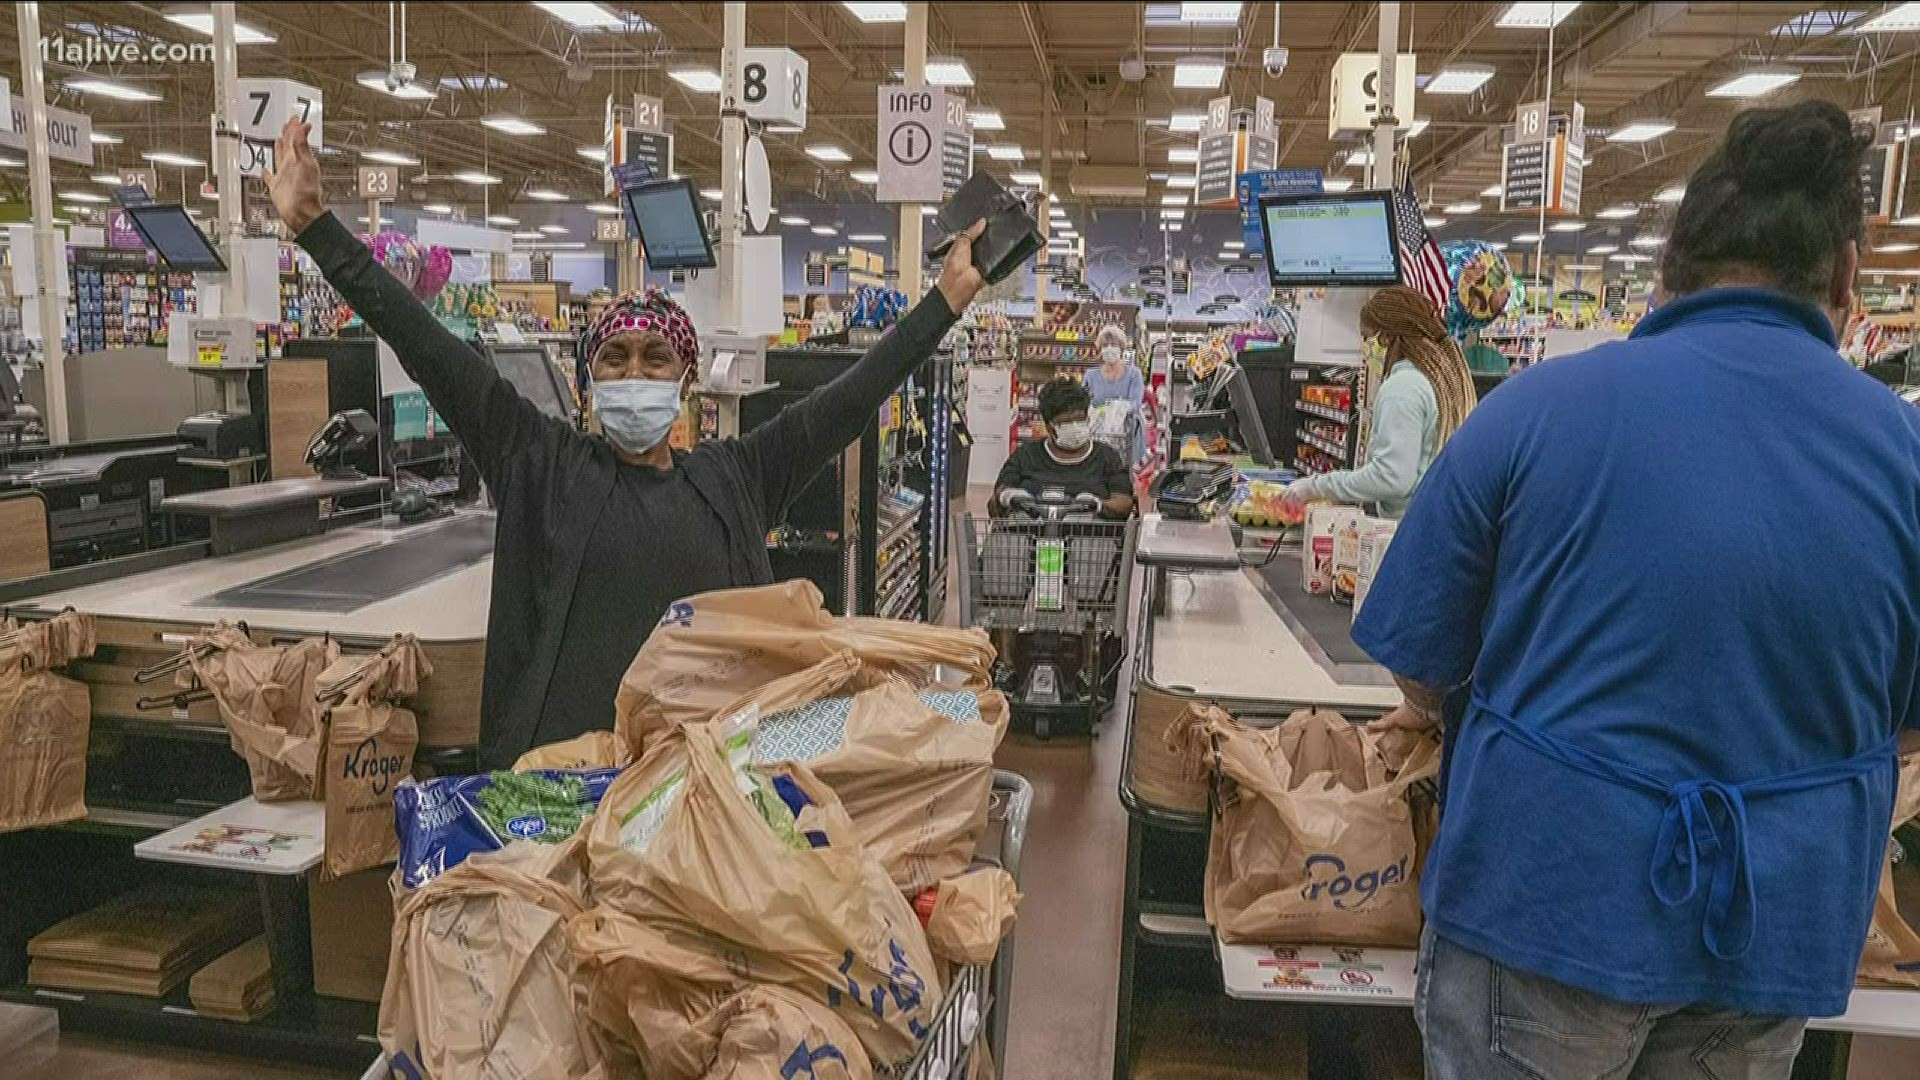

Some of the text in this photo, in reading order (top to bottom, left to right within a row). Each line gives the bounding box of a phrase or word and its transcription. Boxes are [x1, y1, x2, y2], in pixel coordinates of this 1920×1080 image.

[744, 64, 768, 103] 8
[793, 70, 801, 110] 8
[249, 91, 270, 126] 7
[297, 96, 311, 123] 7
[639, 102, 659, 126] 21
[890, 94, 932, 113] INFO
[947, 101, 963, 127] 20
[1212, 105, 1226, 131] 19
[1260, 107, 1272, 131] 19
[1521, 109, 1539, 135] 18
[367, 172, 388, 193] 23
[603, 222, 618, 239] 23
[1089, 309, 1122, 321] SALTY
[343, 734, 405, 797] Kroger
